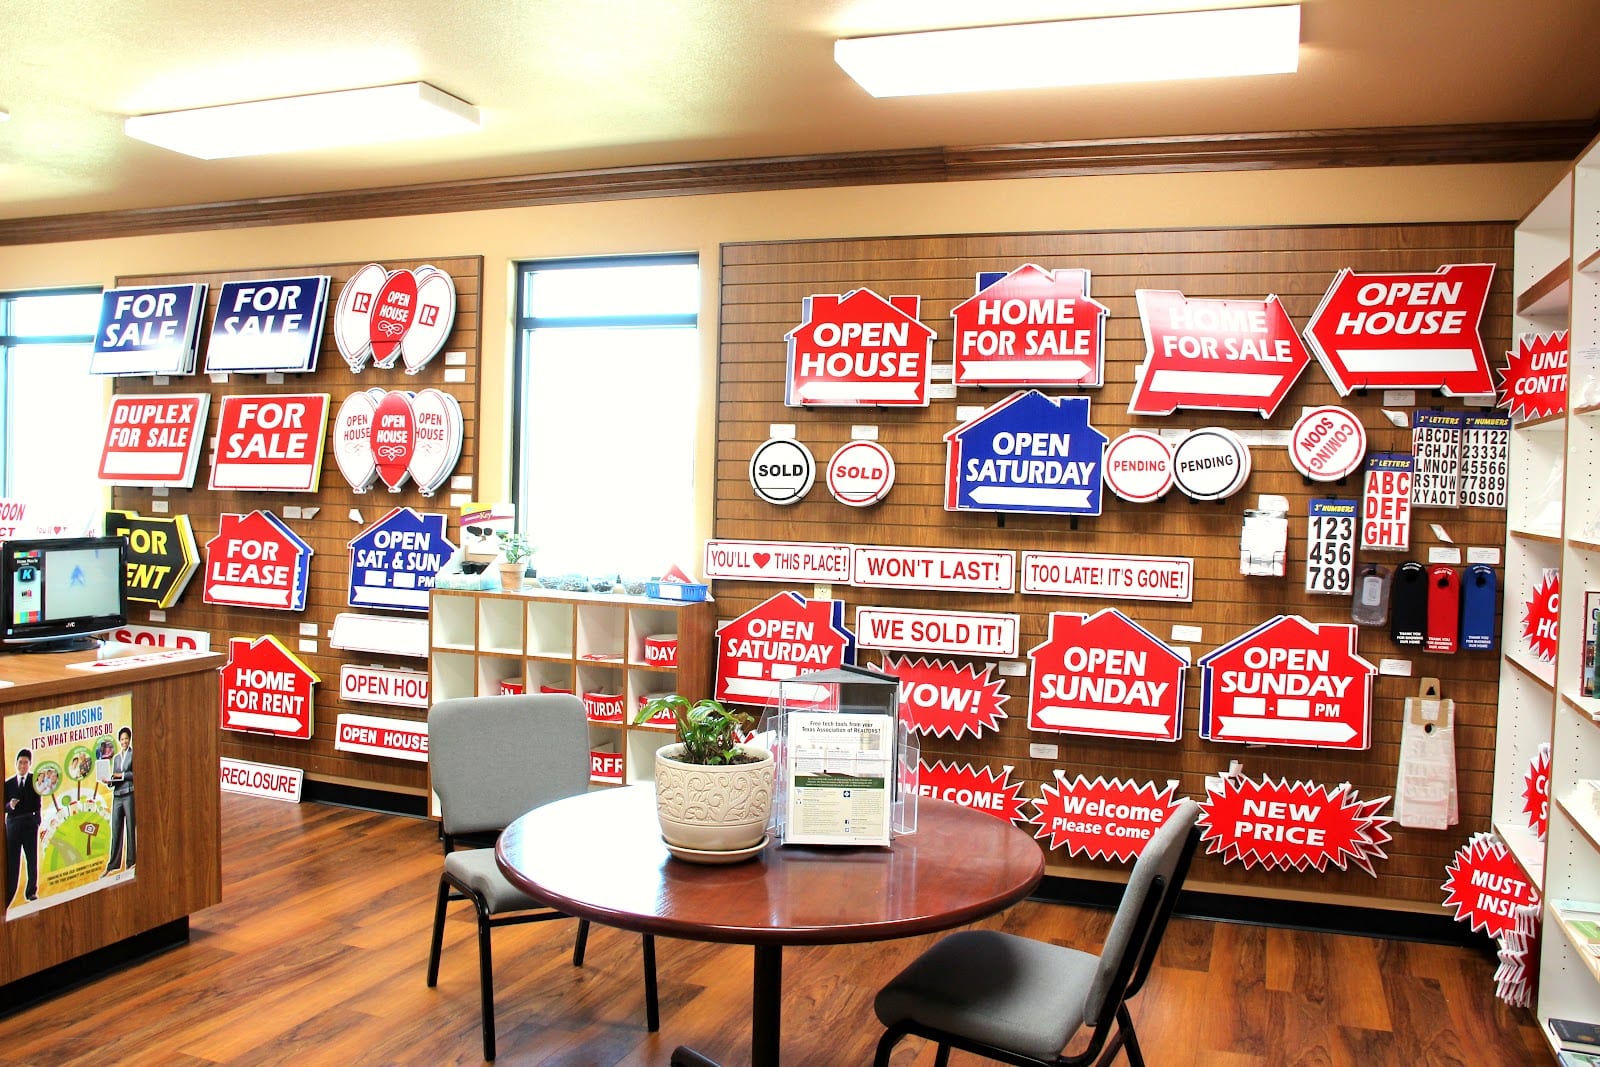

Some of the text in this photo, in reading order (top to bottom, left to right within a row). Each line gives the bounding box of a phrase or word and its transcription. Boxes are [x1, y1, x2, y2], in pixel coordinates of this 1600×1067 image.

[233, 285, 302, 313] FOR
[387, 290, 411, 307] OPEN
[1356, 281, 1463, 306] OPEN
[114, 293, 177, 320] FOR
[379, 304, 409, 322] HOUSE
[977, 299, 1076, 325] HOME
[1169, 304, 1269, 333] HOME
[103, 320, 178, 348] SALE
[222, 314, 304, 338] SALE
[812, 322, 910, 348] OPEN
[1335, 310, 1468, 335] HOUSE
[962, 330, 1091, 356] FOR SALE
[1163, 336, 1293, 363] FOR SALE
[800, 352, 921, 377] HOUSE
[114, 404, 194, 424] DUPLEX
[238, 402, 306, 429] FOR
[346, 414, 368, 427] OPEN
[381, 415, 405, 428] OPEN
[418, 412, 442, 426] OPEN
[1429, 416, 1460, 425] LETTERS
[1475, 418, 1510, 426] NUMBERS
[109, 427, 189, 447] FOR SALE
[226, 432, 308, 459] SALE
[343, 427, 371, 441] HOUSE
[376, 430, 408, 444] HOUSE
[415, 427, 444, 441] HOUSE
[992, 431, 1071, 457] OPEN
[1300, 417, 1335, 452] SOON
[1310, 422, 1355, 471] COMING
[758, 464, 804, 477] SOLD
[835, 465, 883, 481] SOLD
[966, 457, 1097, 486] SATURDAY
[1113, 460, 1166, 472] PENDING
[1180, 453, 1234, 473] PENDING
[1322, 505, 1355, 513] NUMBERS
[226, 539, 279, 561] FOR
[373, 530, 431, 551] OPEN
[356, 550, 441, 572] SAT. & SUN
[711, 551, 847, 573] YOU'LL THIS PLACE!
[867, 557, 1001, 582] WON'T LAST!
[127, 563, 171, 589] ENT
[211, 562, 289, 586] LEASE
[417, 577, 436, 588] PM
[1031, 565, 1184, 589] TOO LATE! IT'S GONE!
[747, 618, 815, 641] OPEN
[870, 620, 1002, 646] WE SOLD IT!
[726, 637, 834, 664] SATURDAY
[1063, 646, 1147, 676] OPEN
[1242, 646, 1329, 672] OPEN
[236, 668, 296, 692] HOME
[345, 674, 428, 699] OPEN HOU
[1040, 674, 1170, 708] SUNDAY
[1221, 671, 1354, 699] SUNDAY
[227, 690, 304, 715] FOR RENT
[1315, 704, 1340, 718] PM
[39, 706, 103, 733] FAIR HOUSING
[31, 736, 46, 750] IT'S
[47, 731, 67, 747] WHAT
[69, 725, 103, 742] REALTORS
[104, 723, 113, 735] DO
[343, 727, 428, 751] OPEN HOUSE
[219, 766, 297, 794] RECLOSURE
[1063, 795, 1164, 822] Welcome
[1242, 799, 1322, 822] NEW
[1052, 817, 1150, 840] Please Come
[1234, 821, 1326, 846] PRICE
[1471, 869, 1526, 897] MUST
[1477, 893, 1516, 919] INSI
